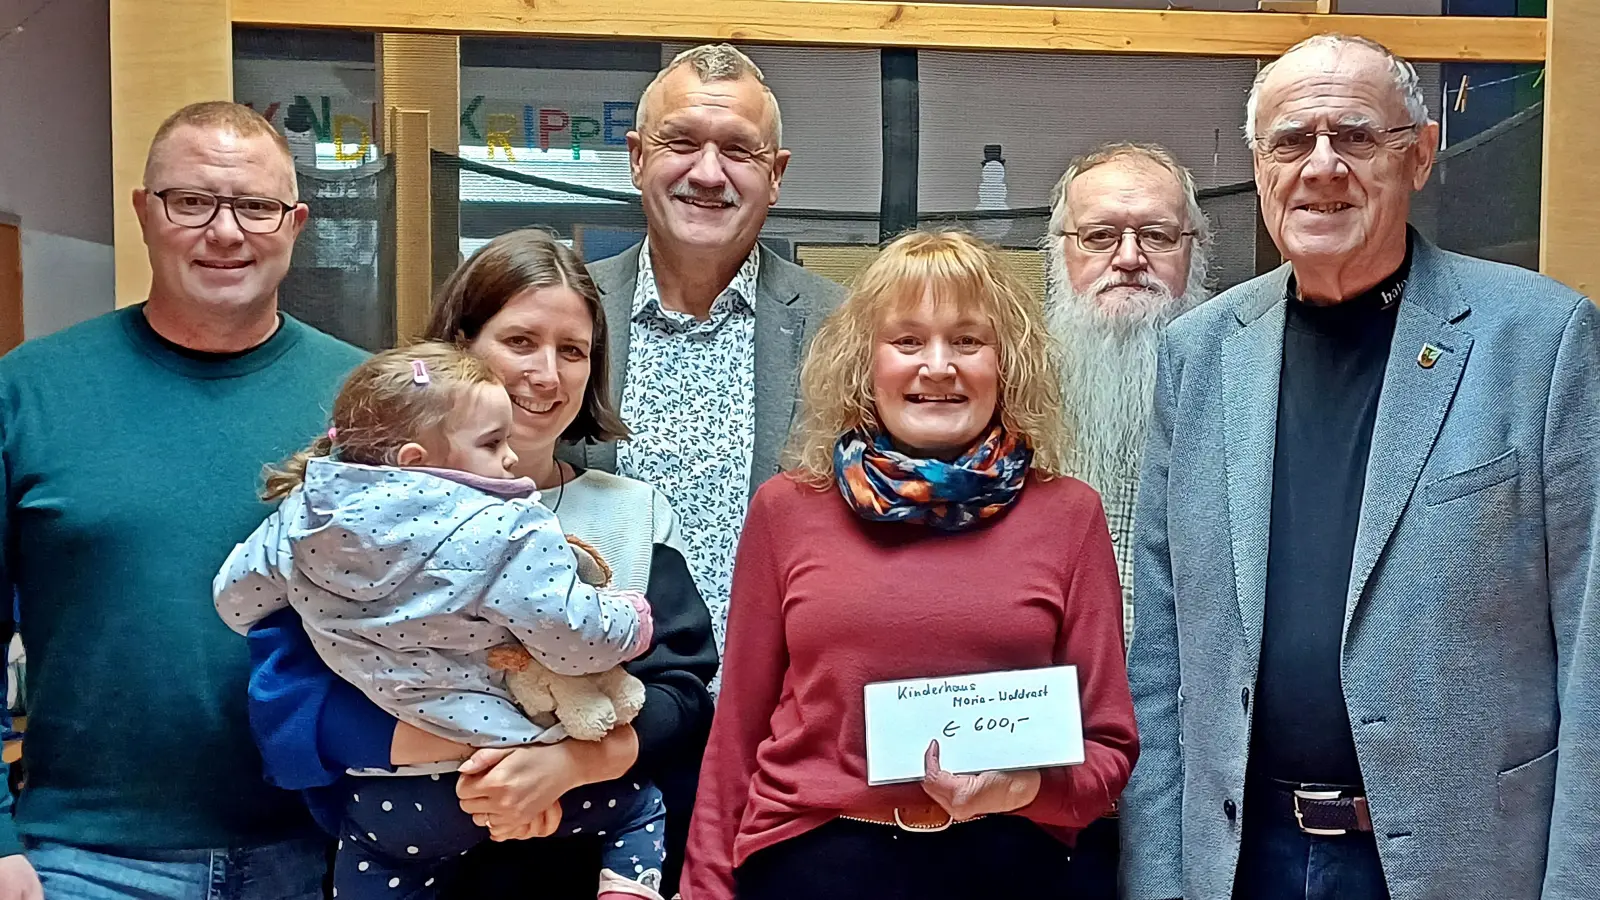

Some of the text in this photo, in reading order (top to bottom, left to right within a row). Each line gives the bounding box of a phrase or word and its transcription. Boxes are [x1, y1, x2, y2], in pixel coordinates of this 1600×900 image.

[897, 681, 977, 700] Kinderhaus
[942, 716, 1030, 737] € 600,-
